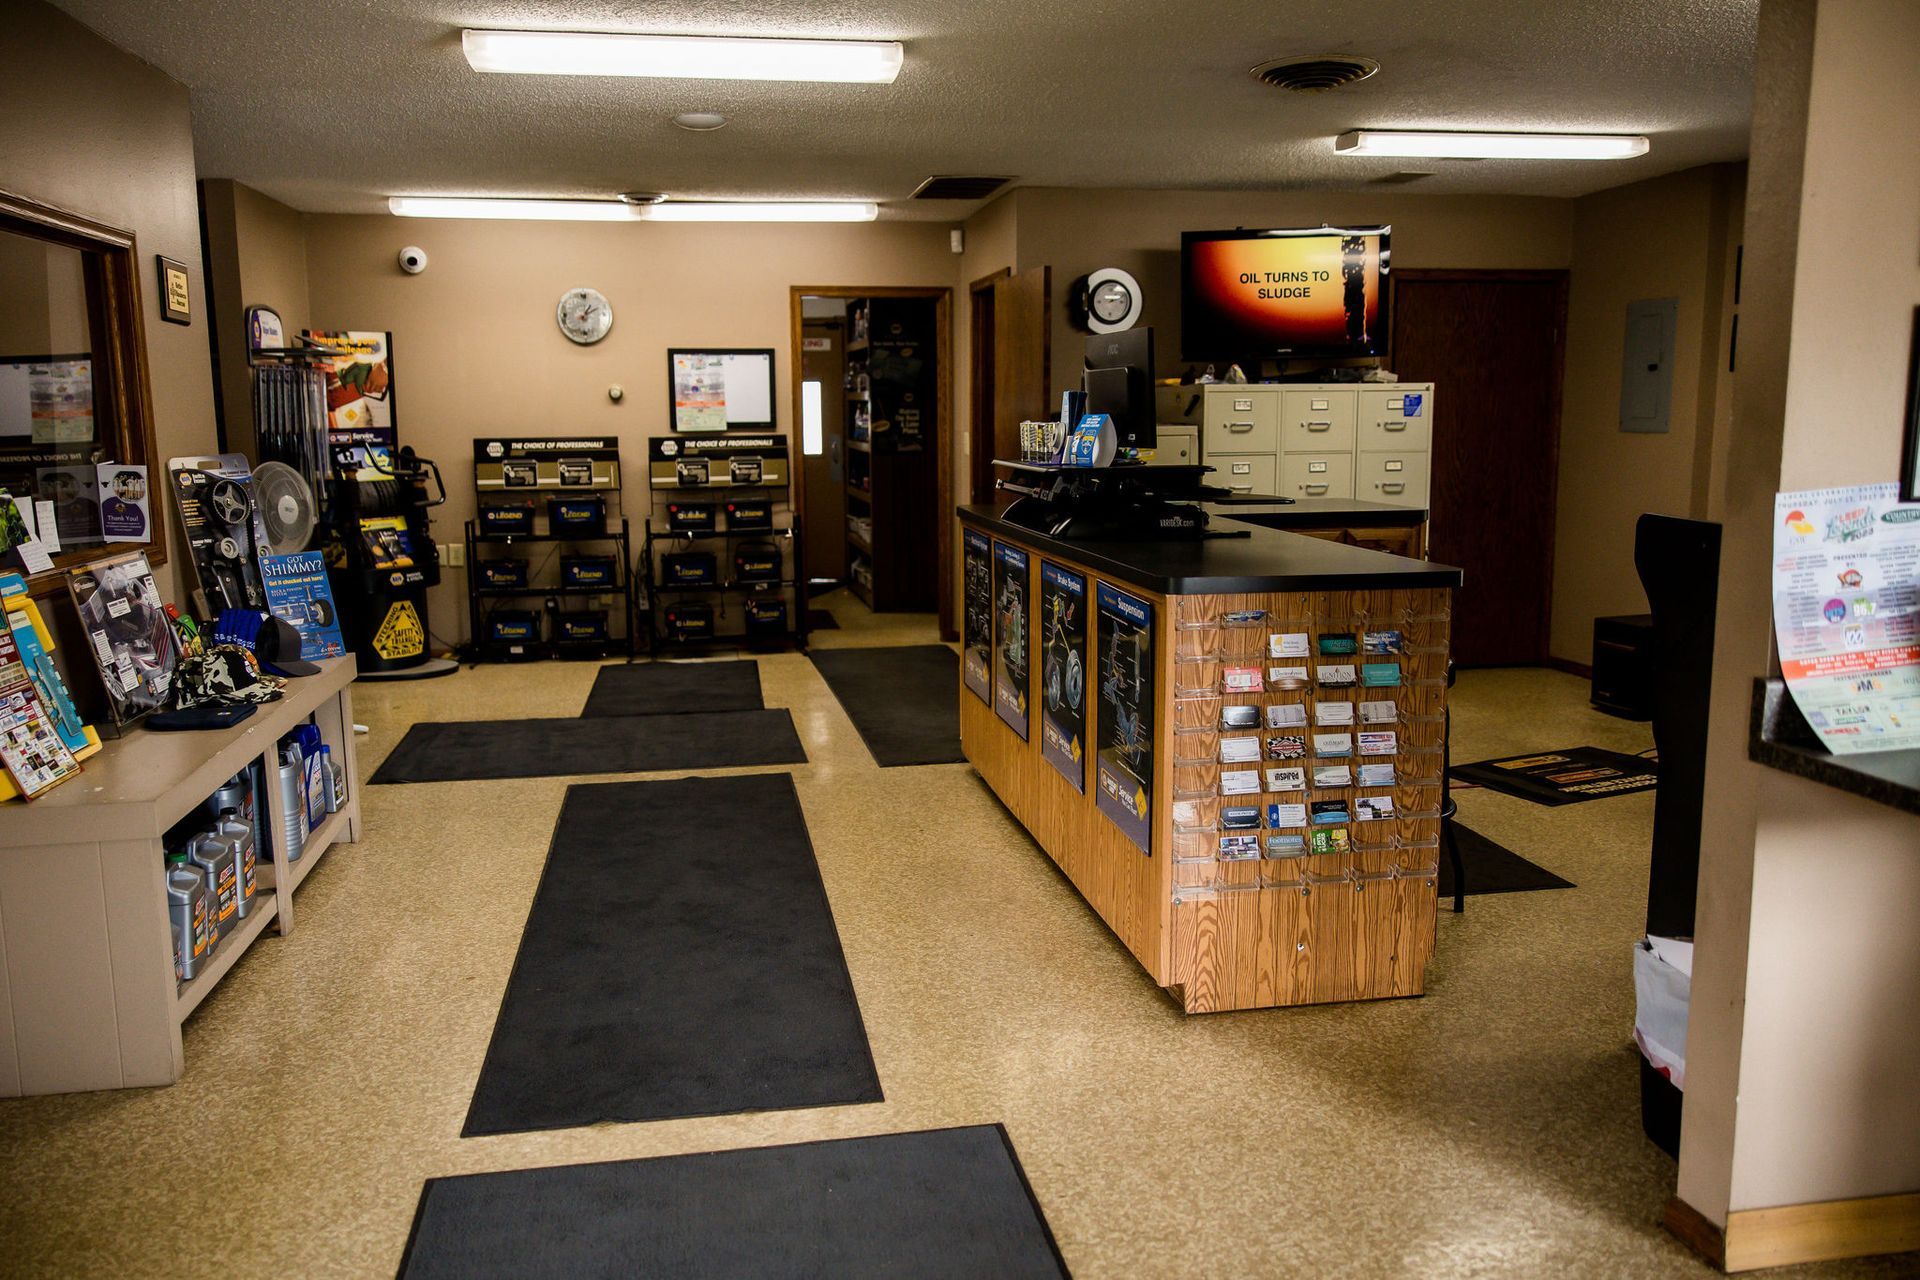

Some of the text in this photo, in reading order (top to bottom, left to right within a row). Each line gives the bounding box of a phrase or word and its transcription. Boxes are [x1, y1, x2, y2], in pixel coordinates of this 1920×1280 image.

[1239, 270, 1330, 284] OIL TURNS TO
[1258, 287, 1311, 299] SLUDGE
[352, 432, 374, 440] Service
[556, 441, 604, 449] PROFESSIONALS
[696, 440, 718, 448] CHOICE
[727, 439, 773, 447] PROFESSIONALS
[286, 555, 303, 564] GOT
[1833, 553, 1868, 561] PRESENTED
[264, 560, 322, 577] SHIMMY?
[283, 577, 303, 585] checked
[1057, 572, 1081, 592] Brake System
[1117, 597, 1145, 621] Suspension
[1853, 601, 1877, 617] 96.7
[376, 606, 399, 643] STEERING
[394, 628, 413, 637] SAFETY
[391, 636, 417, 645] TRIANGLE
[386, 647, 420, 657] STABILITY
[1321, 671, 1352, 680] IGNITION
[1836, 705, 1870, 715] TAYLOR
[1058, 735, 1071, 749] Service
[1274, 772, 1300, 781] inspired
[1118, 785, 1134, 805] Service
